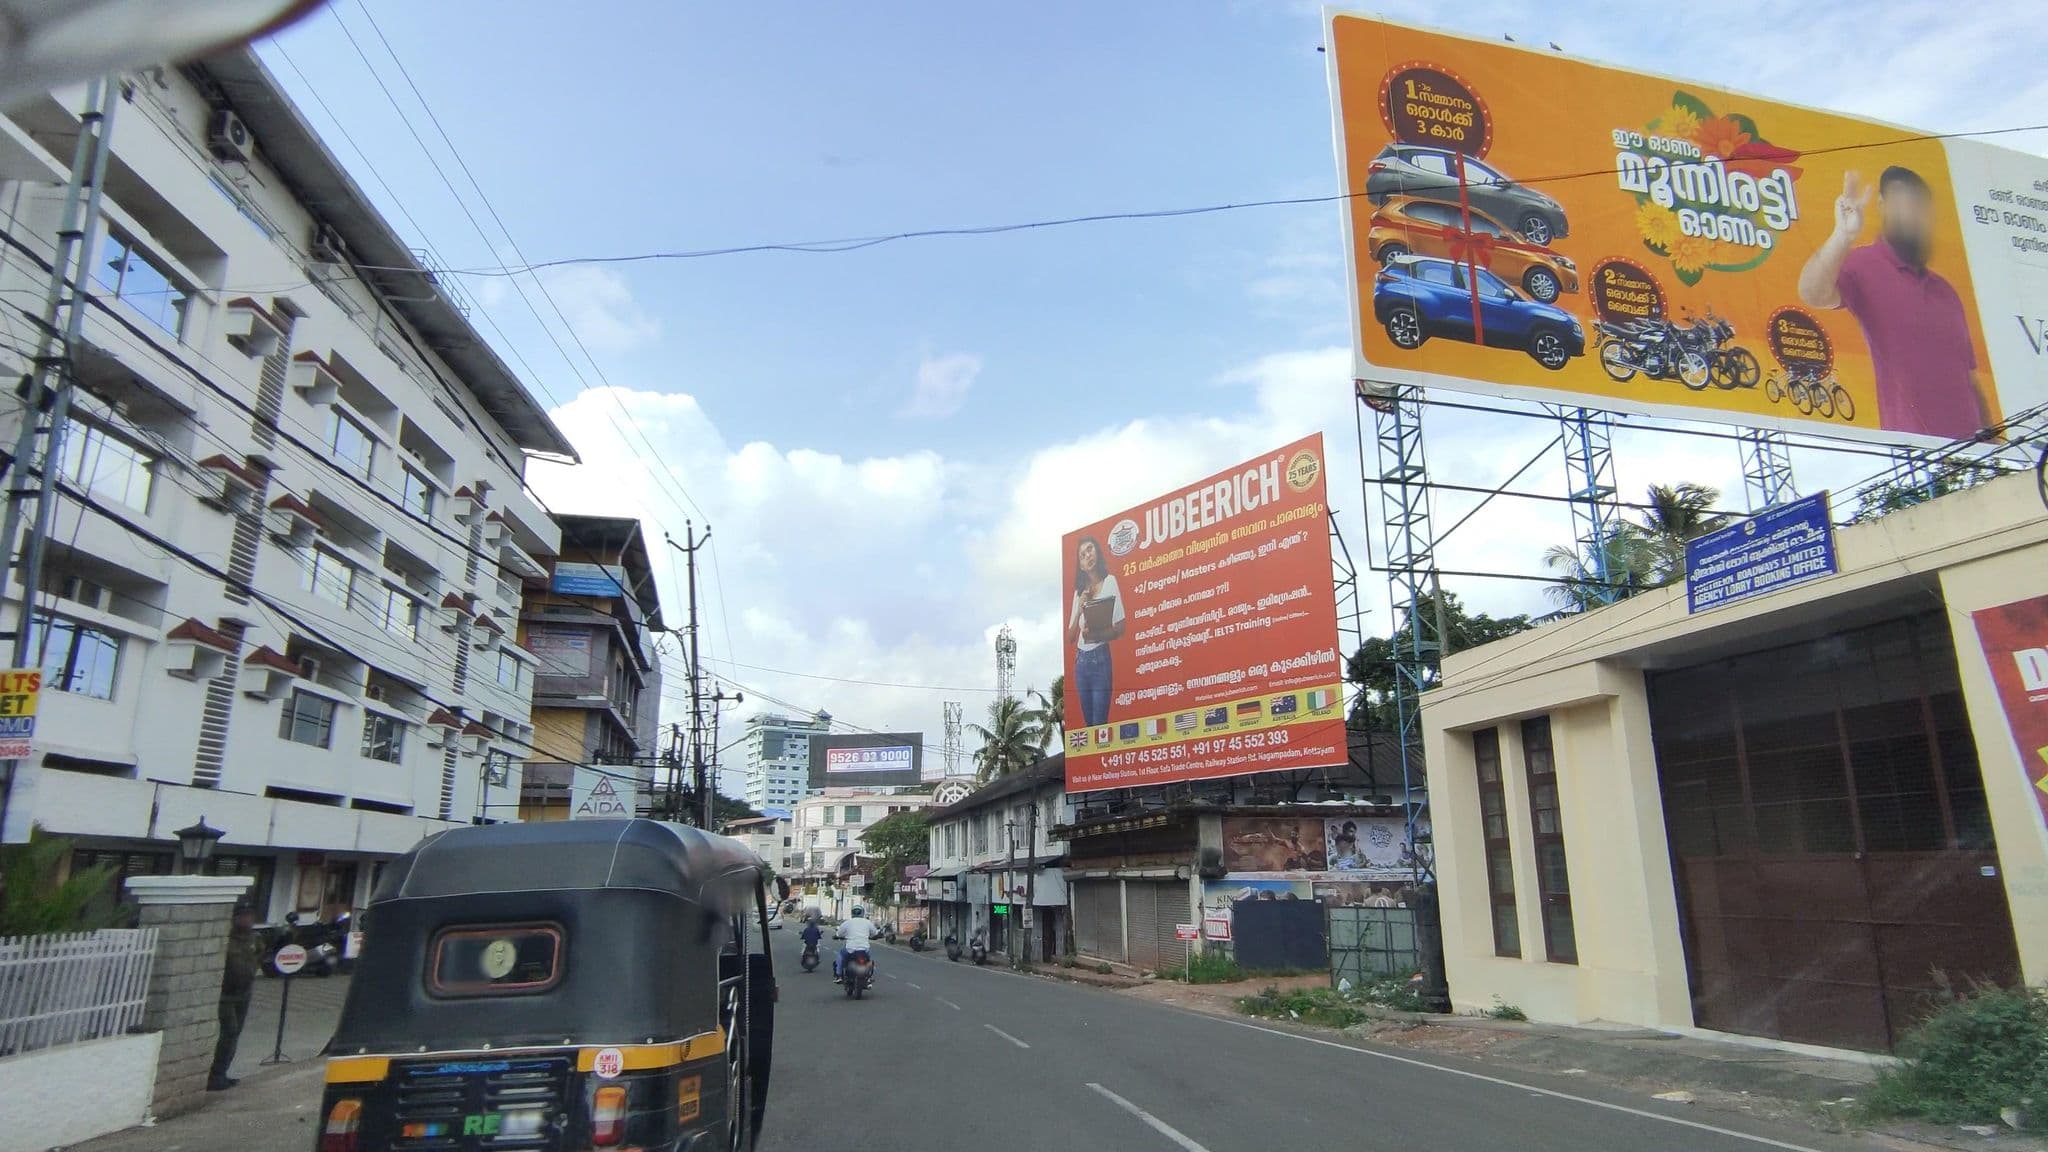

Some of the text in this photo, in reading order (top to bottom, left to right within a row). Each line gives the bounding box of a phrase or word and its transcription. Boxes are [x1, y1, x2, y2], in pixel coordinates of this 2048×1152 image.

[1419, 91, 1472, 110] സമ്മാനം
[1406, 103, 1473, 127] ഒരാൾക്ക്
[1417, 120, 1465, 141] 3 കാർ
[1612, 129, 1701, 158] ഈ ഓണം
[1616, 152, 1799, 231] മൂന്നിരട്ടി
[1678, 208, 1773, 249] ഓണം
[1973, 204, 2048, 234] ഈ ഓണം
[1650, 293, 1658, 304] 3
[1288, 470, 1298, 481] 25
[1122, 562, 1137, 577] 25
[1231, 519, 1267, 541] സേവന
[1269, 502, 1324, 528] പാരമ്പര്യം
[1181, 561, 1216, 580] Masters
[1737, 559, 1780, 581] ROADWAYS
[1694, 588, 1725, 607] AGENCY
[1754, 566, 1791, 588] BOOKING
[1793, 556, 1828, 576] OFFICE
[1214, 624, 1235, 637] IELTS
[1236, 615, 1271, 632] Training
[830, 752, 860, 763] 9526
[880, 750, 909, 761] 9000
[1108, 754, 1122, 767] +91
[1125, 753, 1136, 765] 97
[1138, 751, 1150, 763] 45
[1151, 748, 1168, 761] 525
[1192, 740, 1210, 755] +91
[1213, 739, 1226, 752] 97
[1228, 736, 1242, 751] 45
[1244, 733, 1265, 748] 552
[1267, 730, 1289, 745] 393
[576, 801, 627, 814] AIDA
[601, 1063, 619, 1075] 318
